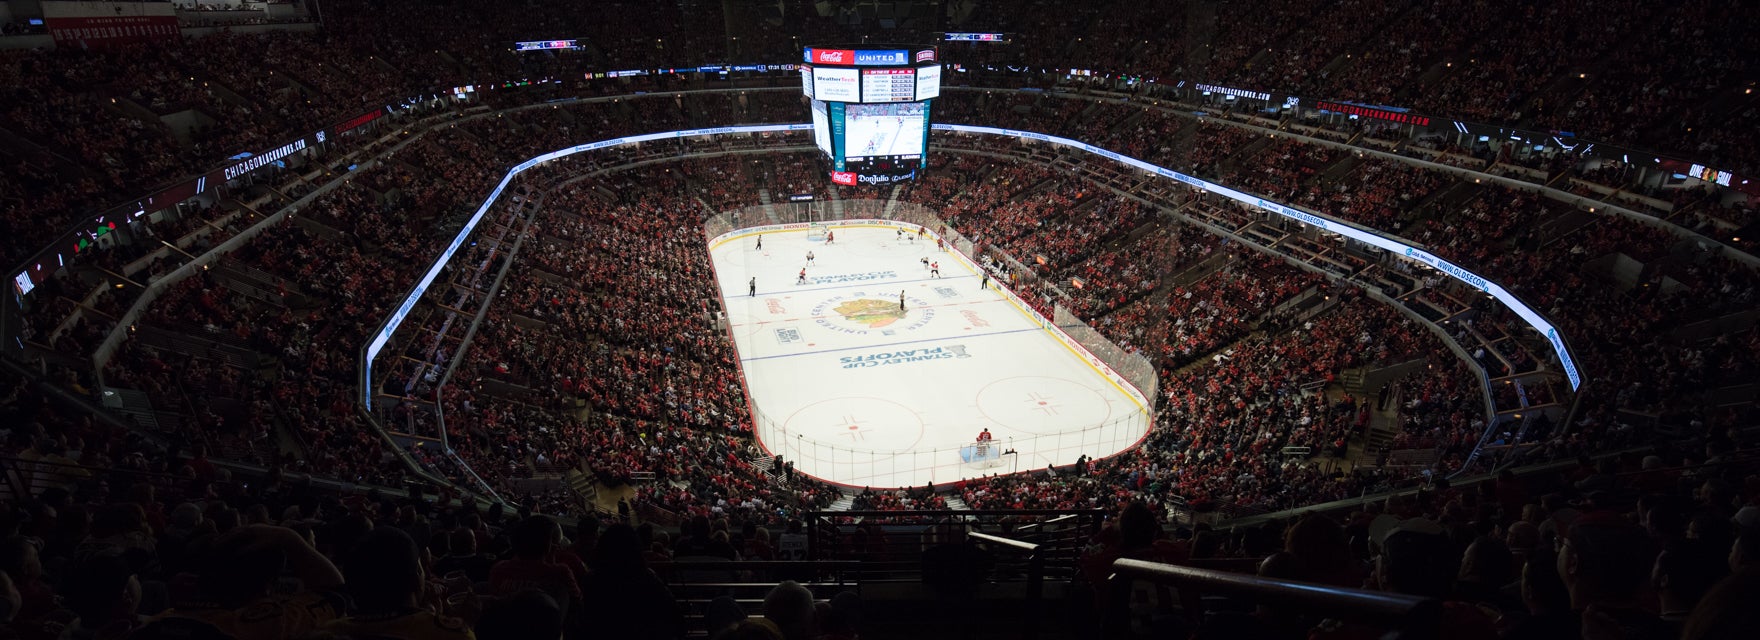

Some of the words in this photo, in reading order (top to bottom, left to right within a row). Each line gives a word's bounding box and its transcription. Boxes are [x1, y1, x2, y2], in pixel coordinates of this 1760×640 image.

[1195, 83, 1271, 101] CHICAGOBLACKHAWKS.COM
[1316, 101, 1429, 126] CHICAGOBLACKHAWKS.COM
[224, 138, 305, 180] CHICAGOBLACKHAWKS.COM
[1689, 163, 1705, 178] ONE
[1715, 170, 1732, 187] GOAL
[815, 318, 867, 335] UNITED
[840, 346, 943, 364] PLAYOFFS
[1067, 339, 1088, 358] HONDA
[842, 360, 879, 369] CUP
[882, 352, 953, 365] STANLEY
